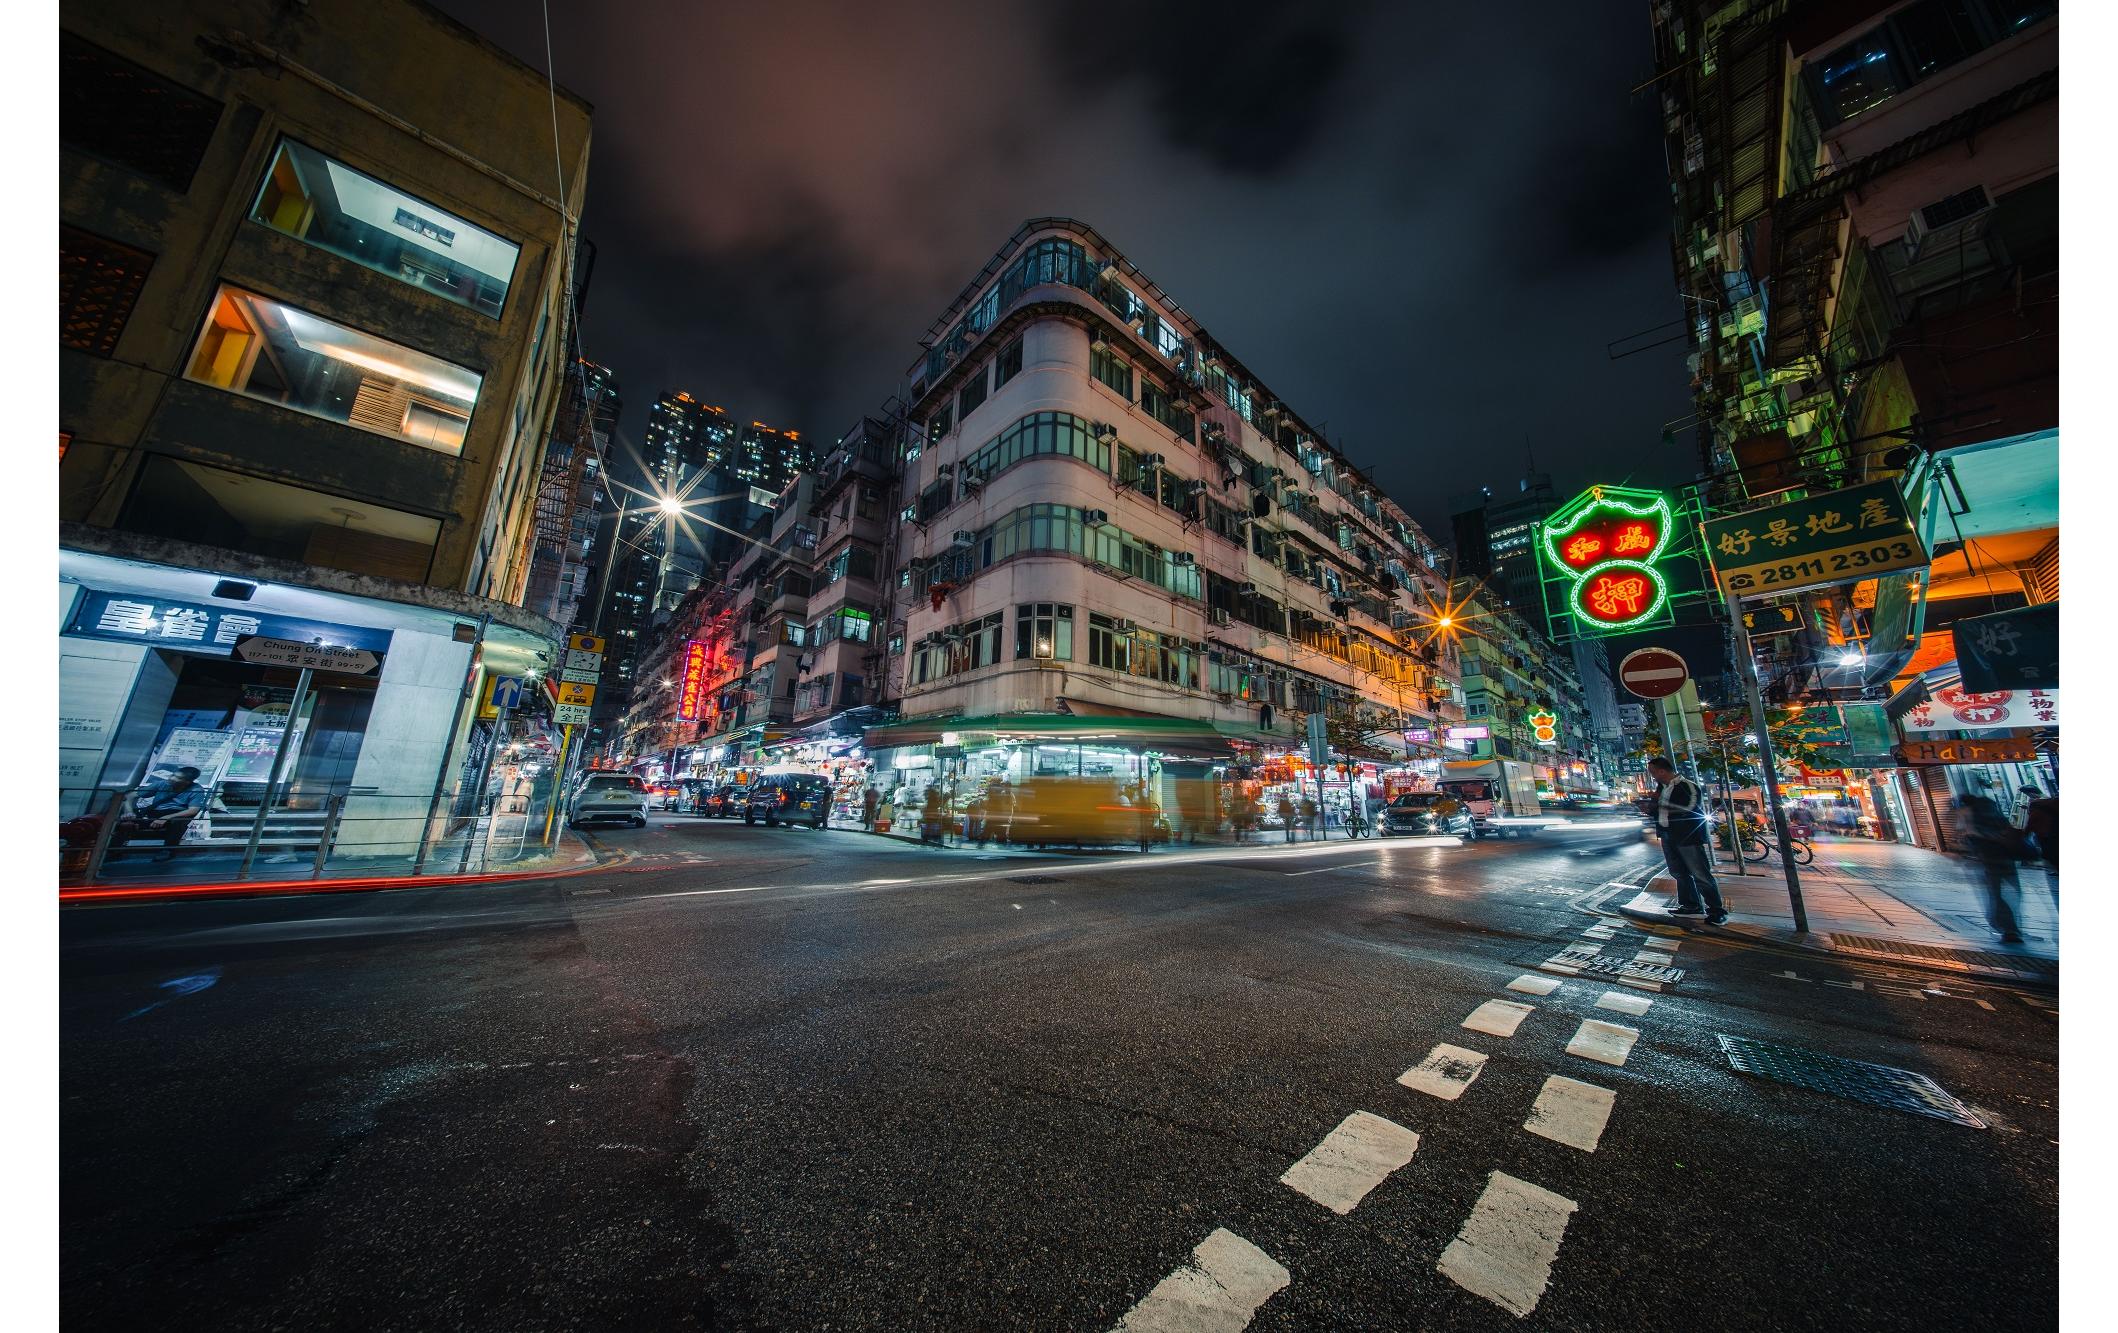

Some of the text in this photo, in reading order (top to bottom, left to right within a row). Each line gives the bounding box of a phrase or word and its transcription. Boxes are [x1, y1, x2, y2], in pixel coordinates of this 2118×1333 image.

[1717, 498, 1899, 556] 好景地產
[1760, 542, 1913, 585] 2811 2303
[263, 640, 360, 659] Chung On Street
[249, 651, 283, 660] 117-101
[286, 653, 334, 668] 眾安街
[561, 713, 583, 723] 全日
[1920, 744, 1985, 761] Hair
